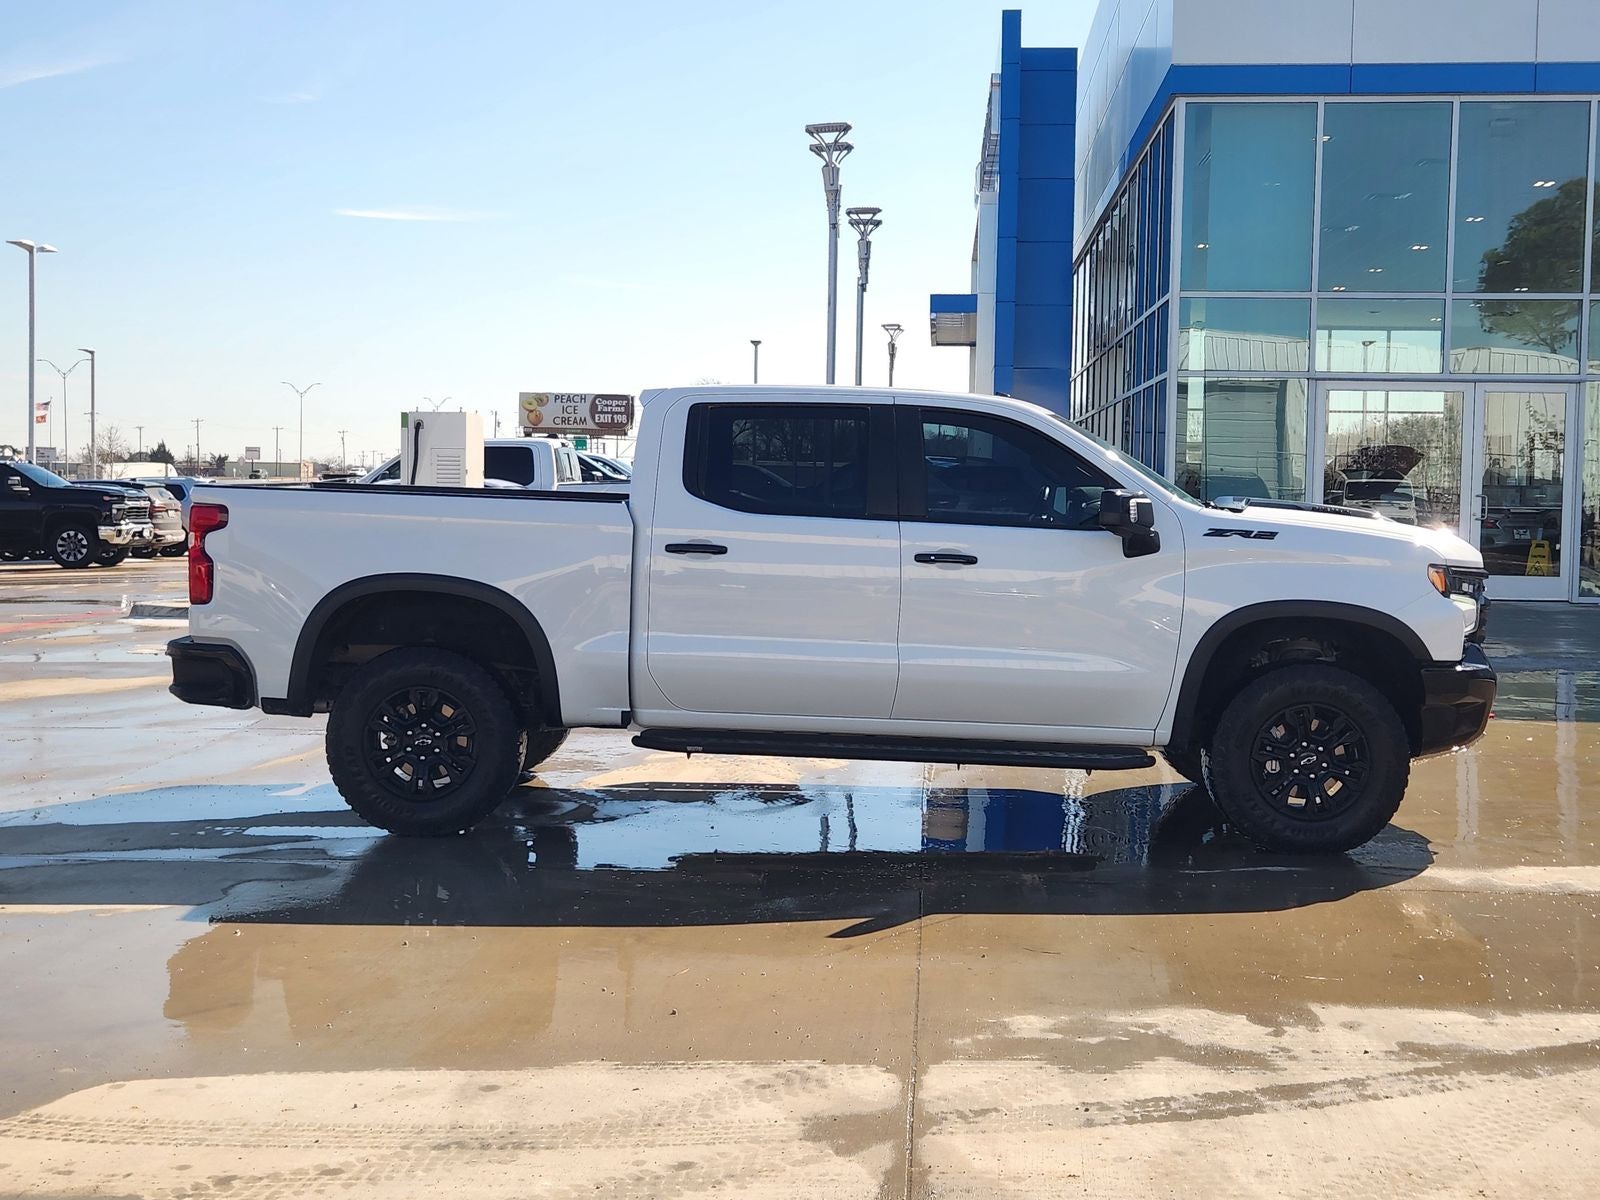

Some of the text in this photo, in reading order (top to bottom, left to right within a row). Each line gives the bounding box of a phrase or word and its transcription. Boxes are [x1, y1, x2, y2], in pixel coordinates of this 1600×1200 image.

[554, 394, 587, 403] PEACH
[595, 398, 628, 406] Cooper
[562, 405, 578, 414] ICE
[553, 416, 587, 425] CREAM
[595, 414, 627, 424] EXIT 198
[1202, 528, 1279, 540] ZR2
